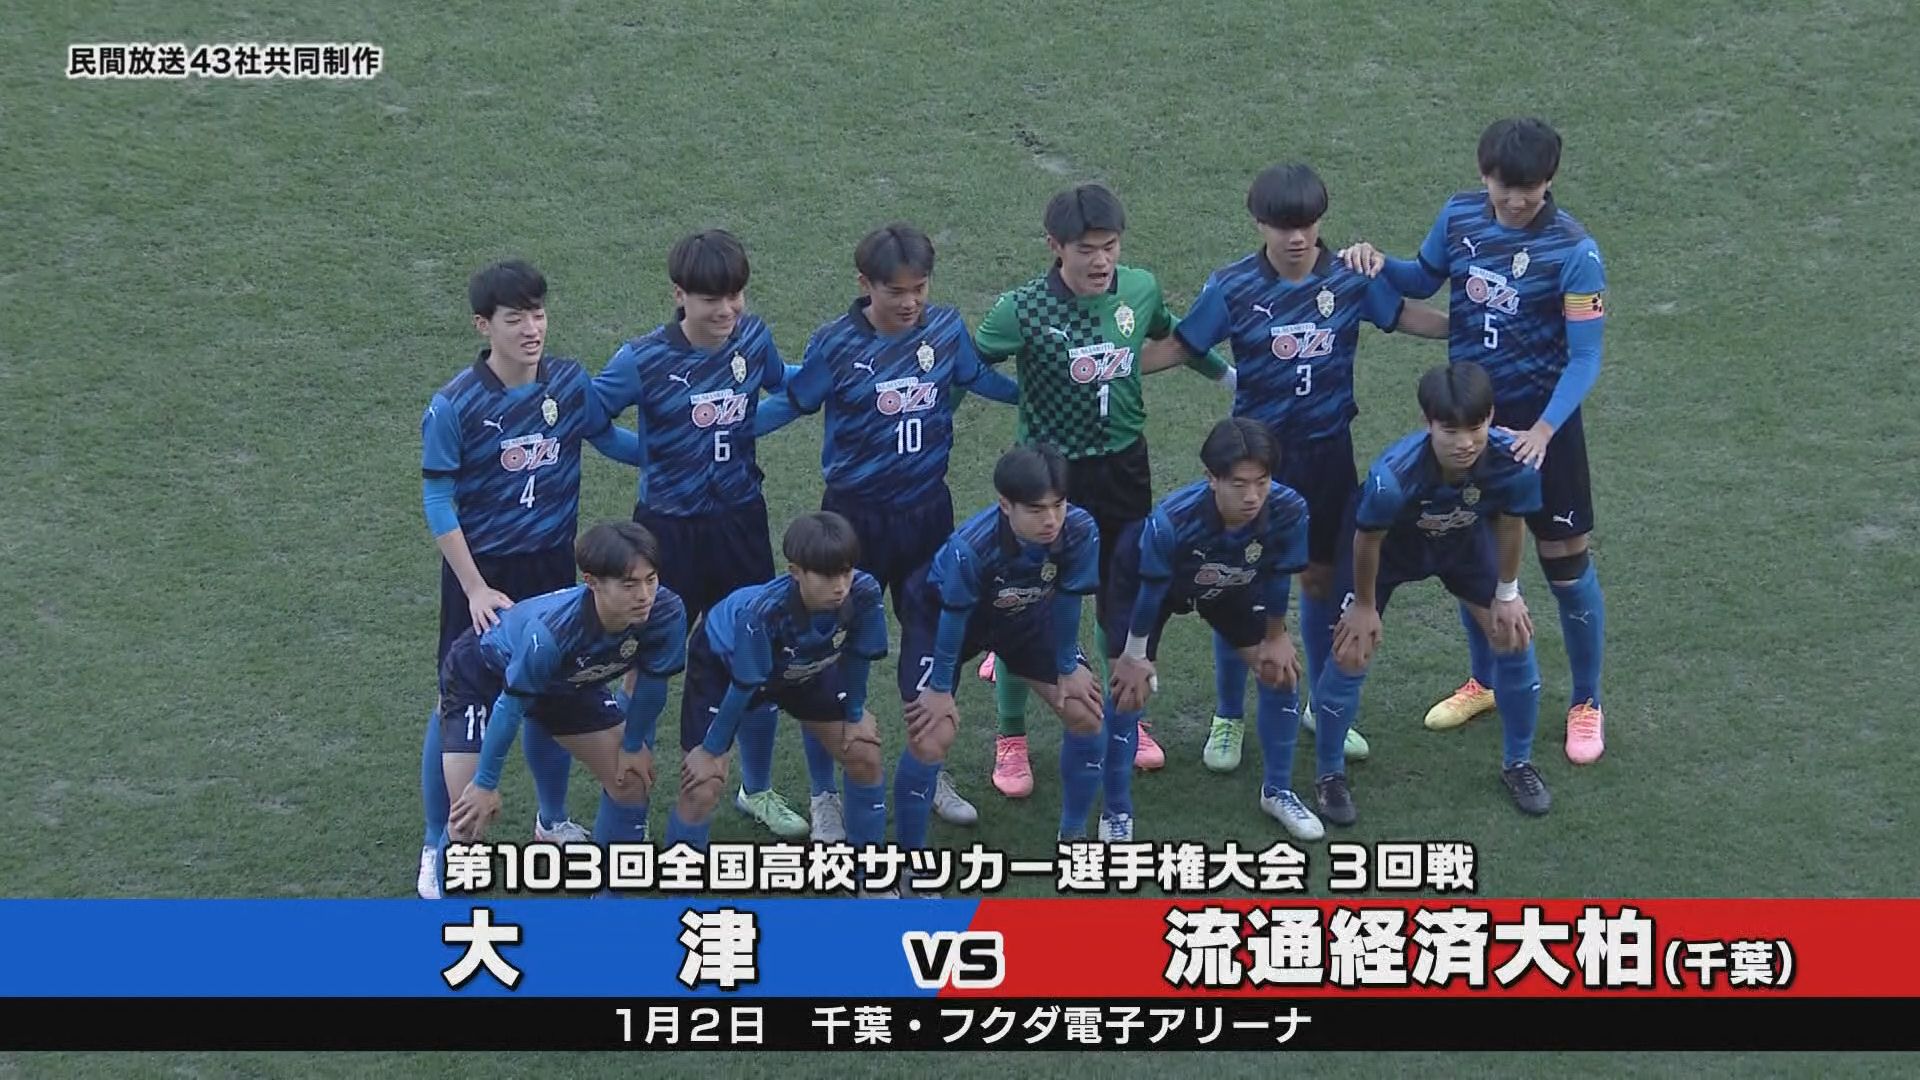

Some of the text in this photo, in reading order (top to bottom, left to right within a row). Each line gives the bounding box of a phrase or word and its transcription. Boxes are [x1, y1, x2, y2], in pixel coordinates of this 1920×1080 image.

[1484, 313, 1498, 349] 5
[1296, 364, 1312, 396] 3
[1097, 384, 1109, 416] 1
[715, 430, 731, 462] 6
[895, 418, 923, 454] 10
[520, 475, 536, 508] 4
[916, 656, 934, 692] 2
[464, 704, 487, 741] 11
